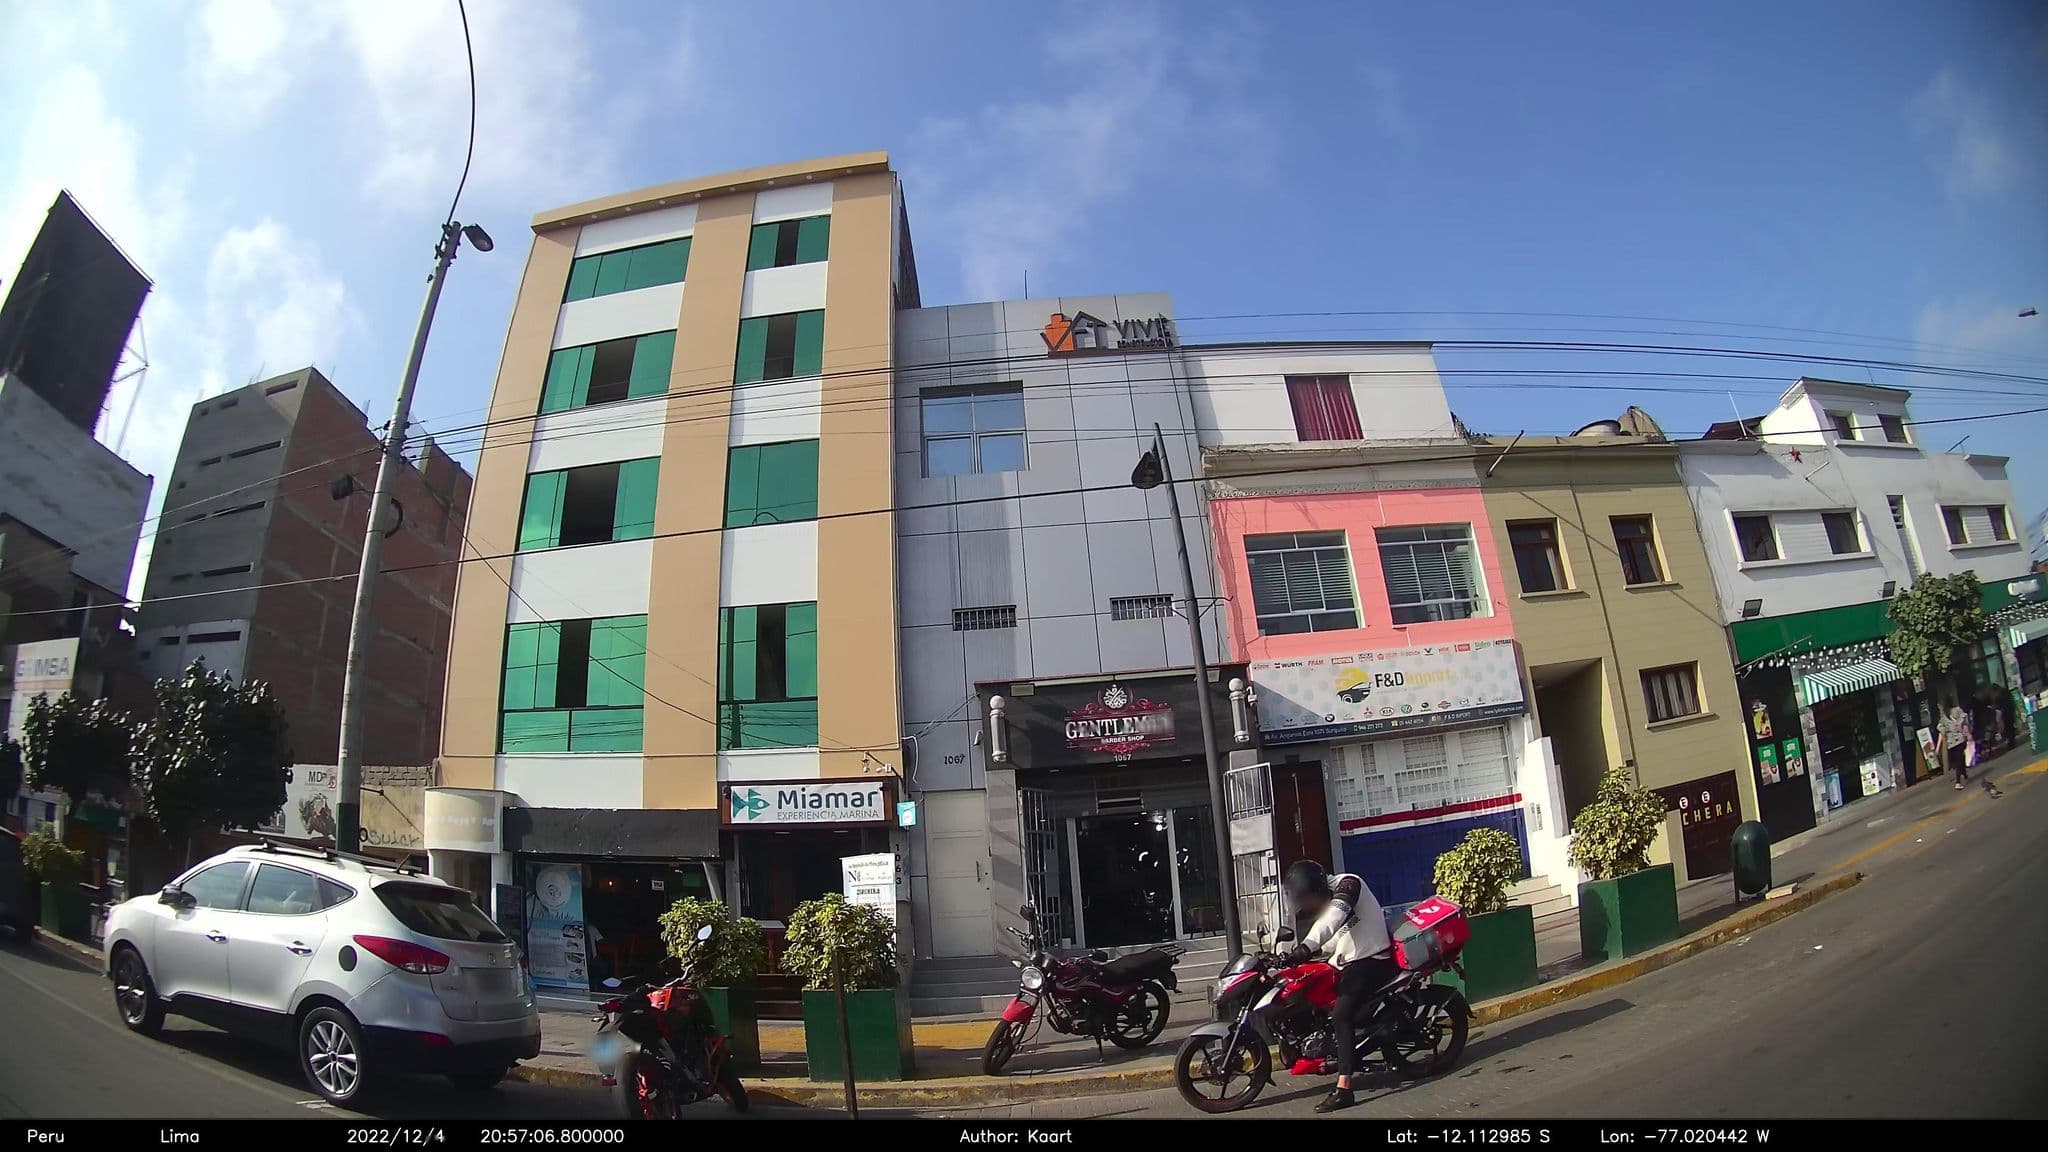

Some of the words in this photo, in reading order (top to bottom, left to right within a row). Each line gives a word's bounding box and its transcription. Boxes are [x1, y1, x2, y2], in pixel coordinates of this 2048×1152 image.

[1375, 672, 1404, 688] F&D
[944, 754, 966, 765] 1067
[777, 787, 878, 810] Miamar
[777, 810, 837, 820] EXPERIENCIA
[839, 809, 879, 819] MARINA
